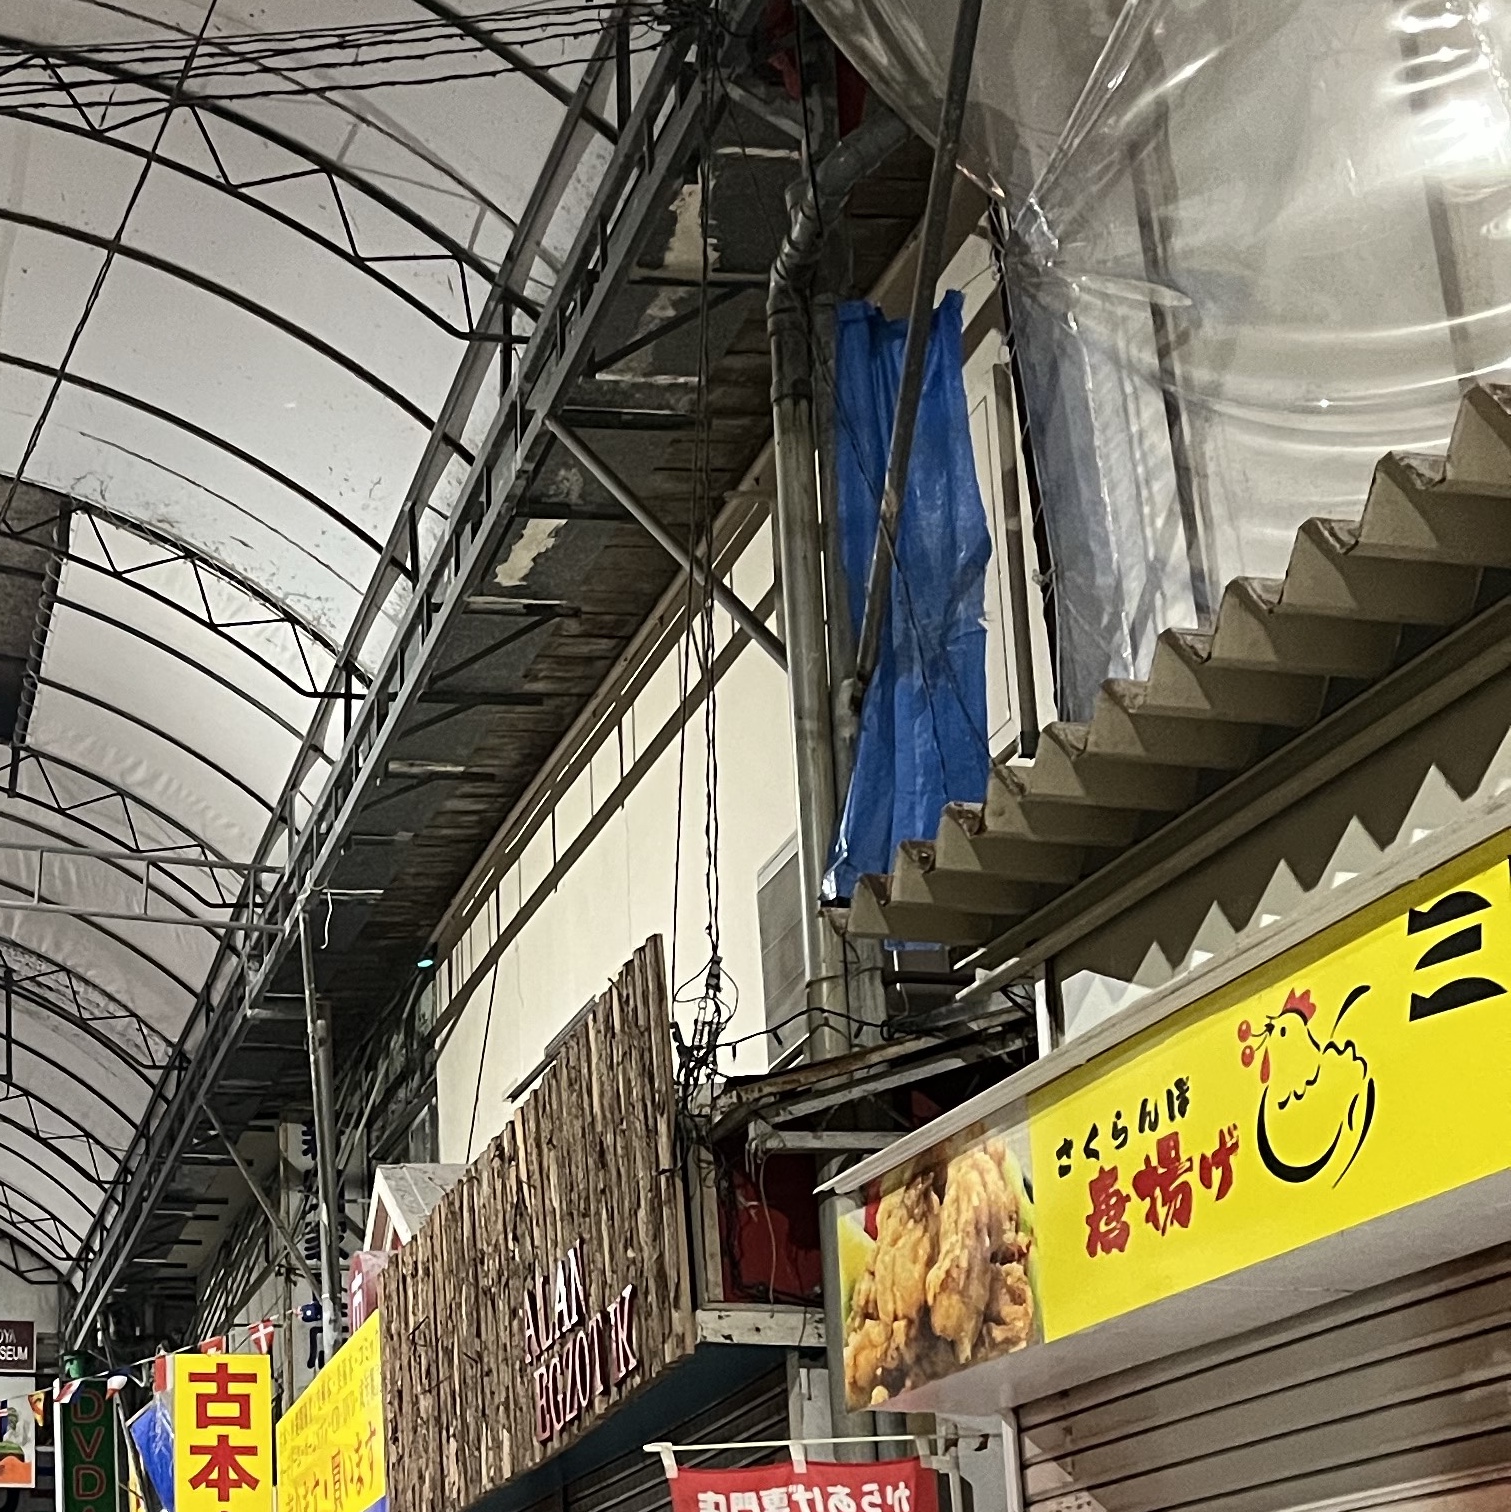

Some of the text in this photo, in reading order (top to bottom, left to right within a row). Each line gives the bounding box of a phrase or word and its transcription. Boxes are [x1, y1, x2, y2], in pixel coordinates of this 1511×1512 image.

[1056, 1076, 1190, 1178] さくらんぼ
[1086, 1123, 1239, 1258] 唐揚げ
[524, 1238, 588, 1364] ALAN
